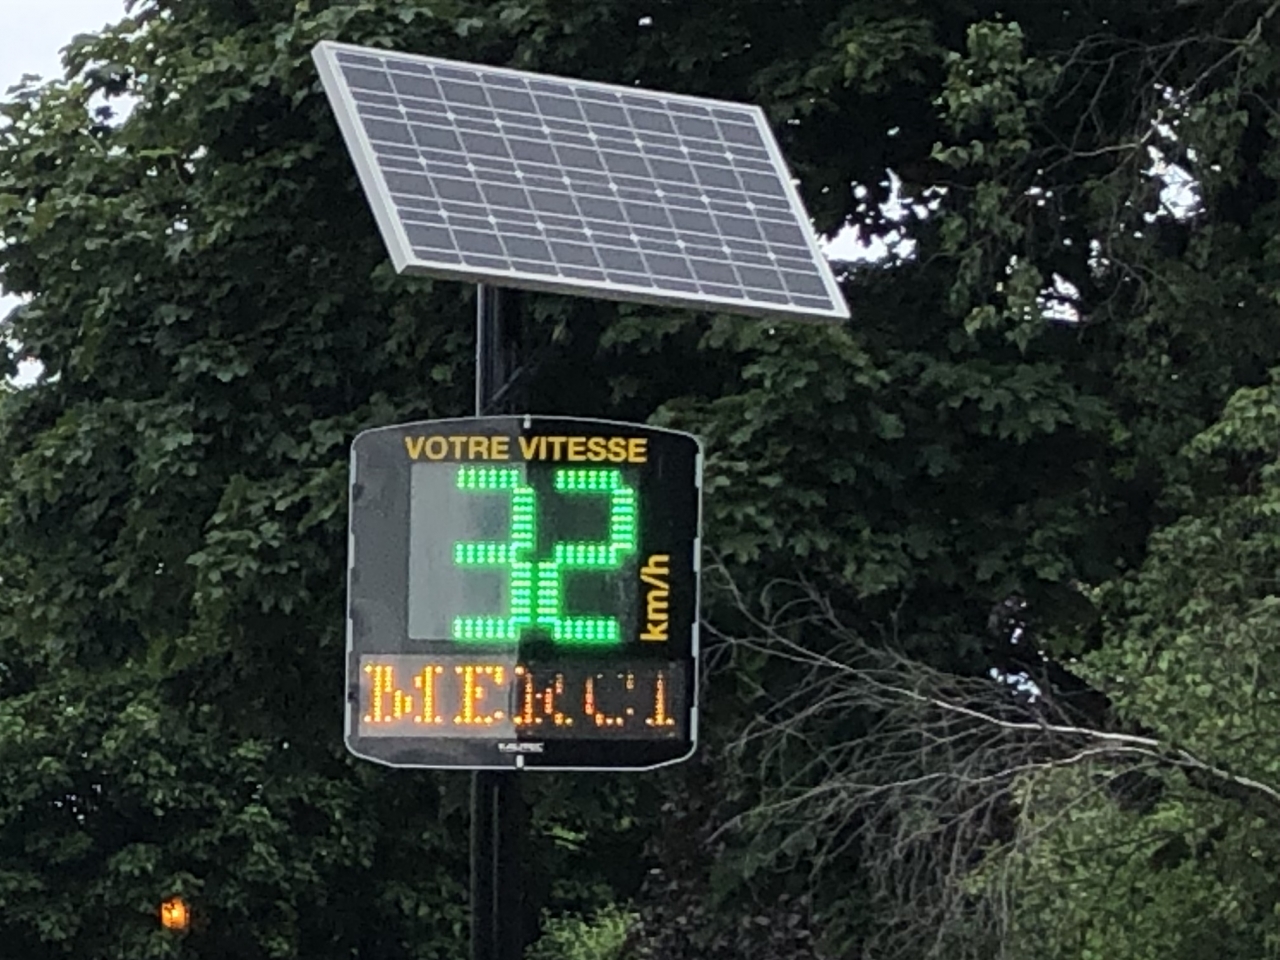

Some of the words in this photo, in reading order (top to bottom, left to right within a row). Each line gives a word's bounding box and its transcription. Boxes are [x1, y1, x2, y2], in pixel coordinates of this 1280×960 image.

[405, 436, 510, 460] VOTRE
[519, 436, 648, 462] VITESSE
[453, 467, 636, 642] 32
[640, 554, 670, 642] km/h
[363, 664, 676, 726] MERCI
